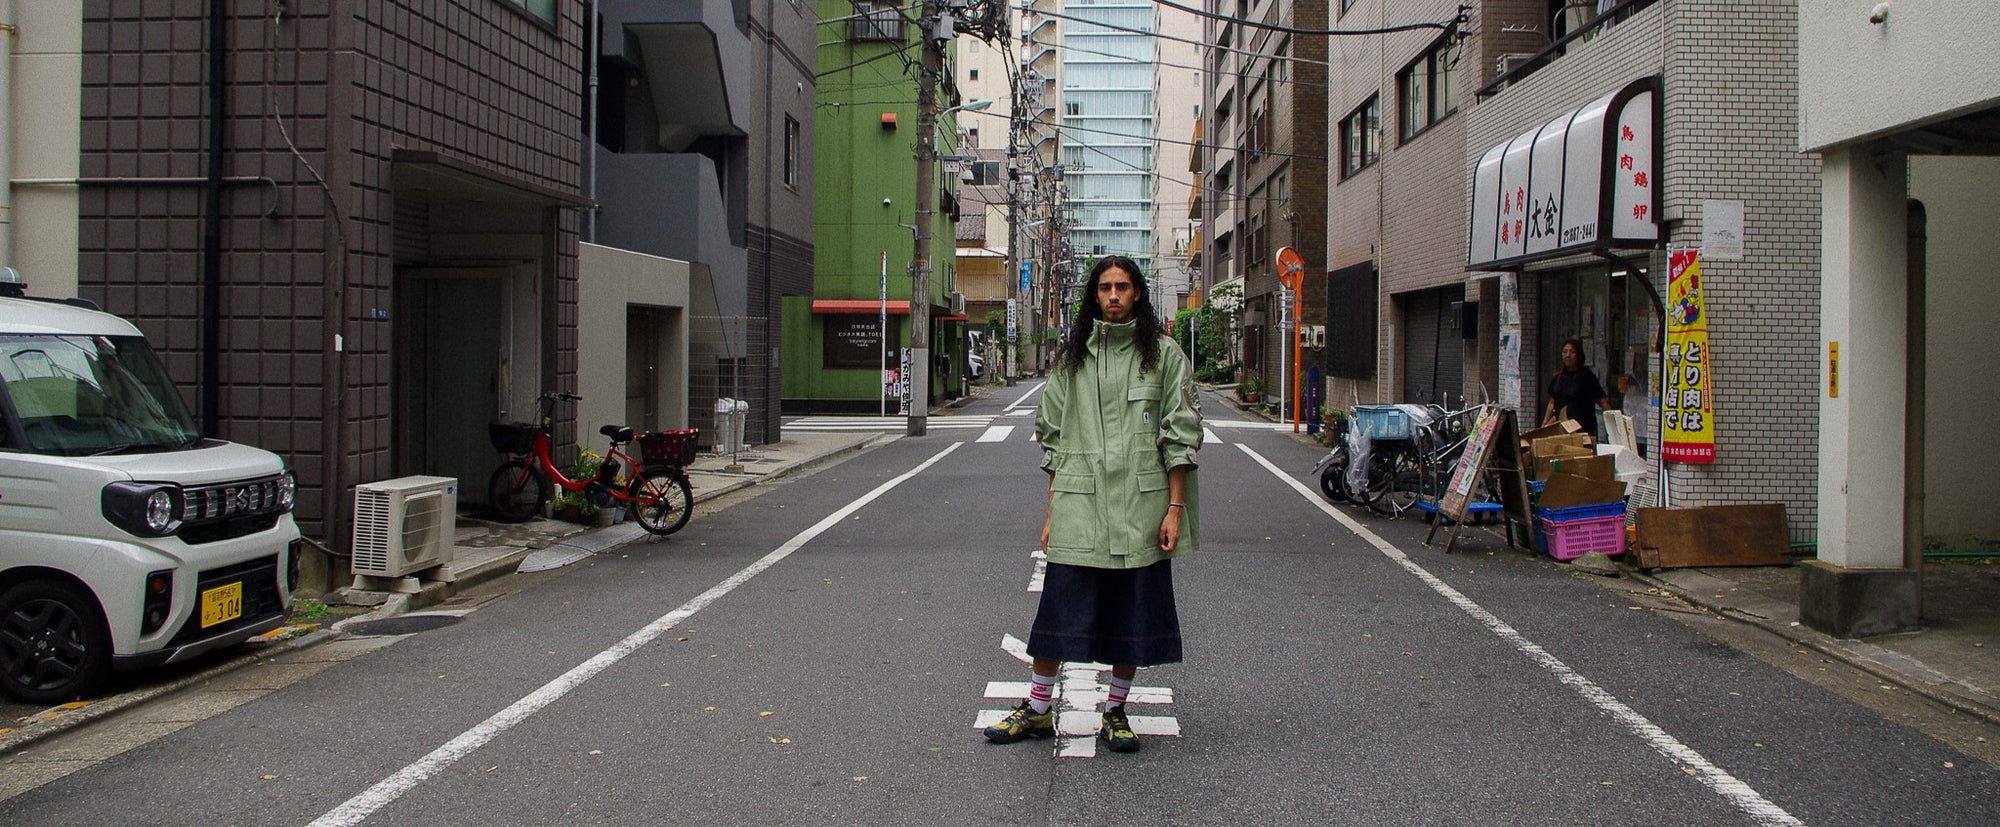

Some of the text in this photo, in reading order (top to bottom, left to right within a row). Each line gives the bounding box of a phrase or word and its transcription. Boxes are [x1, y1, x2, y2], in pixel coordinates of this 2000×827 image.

[1530, 191, 1559, 240] 大金
[1682, 340, 1704, 433] とり肉は
